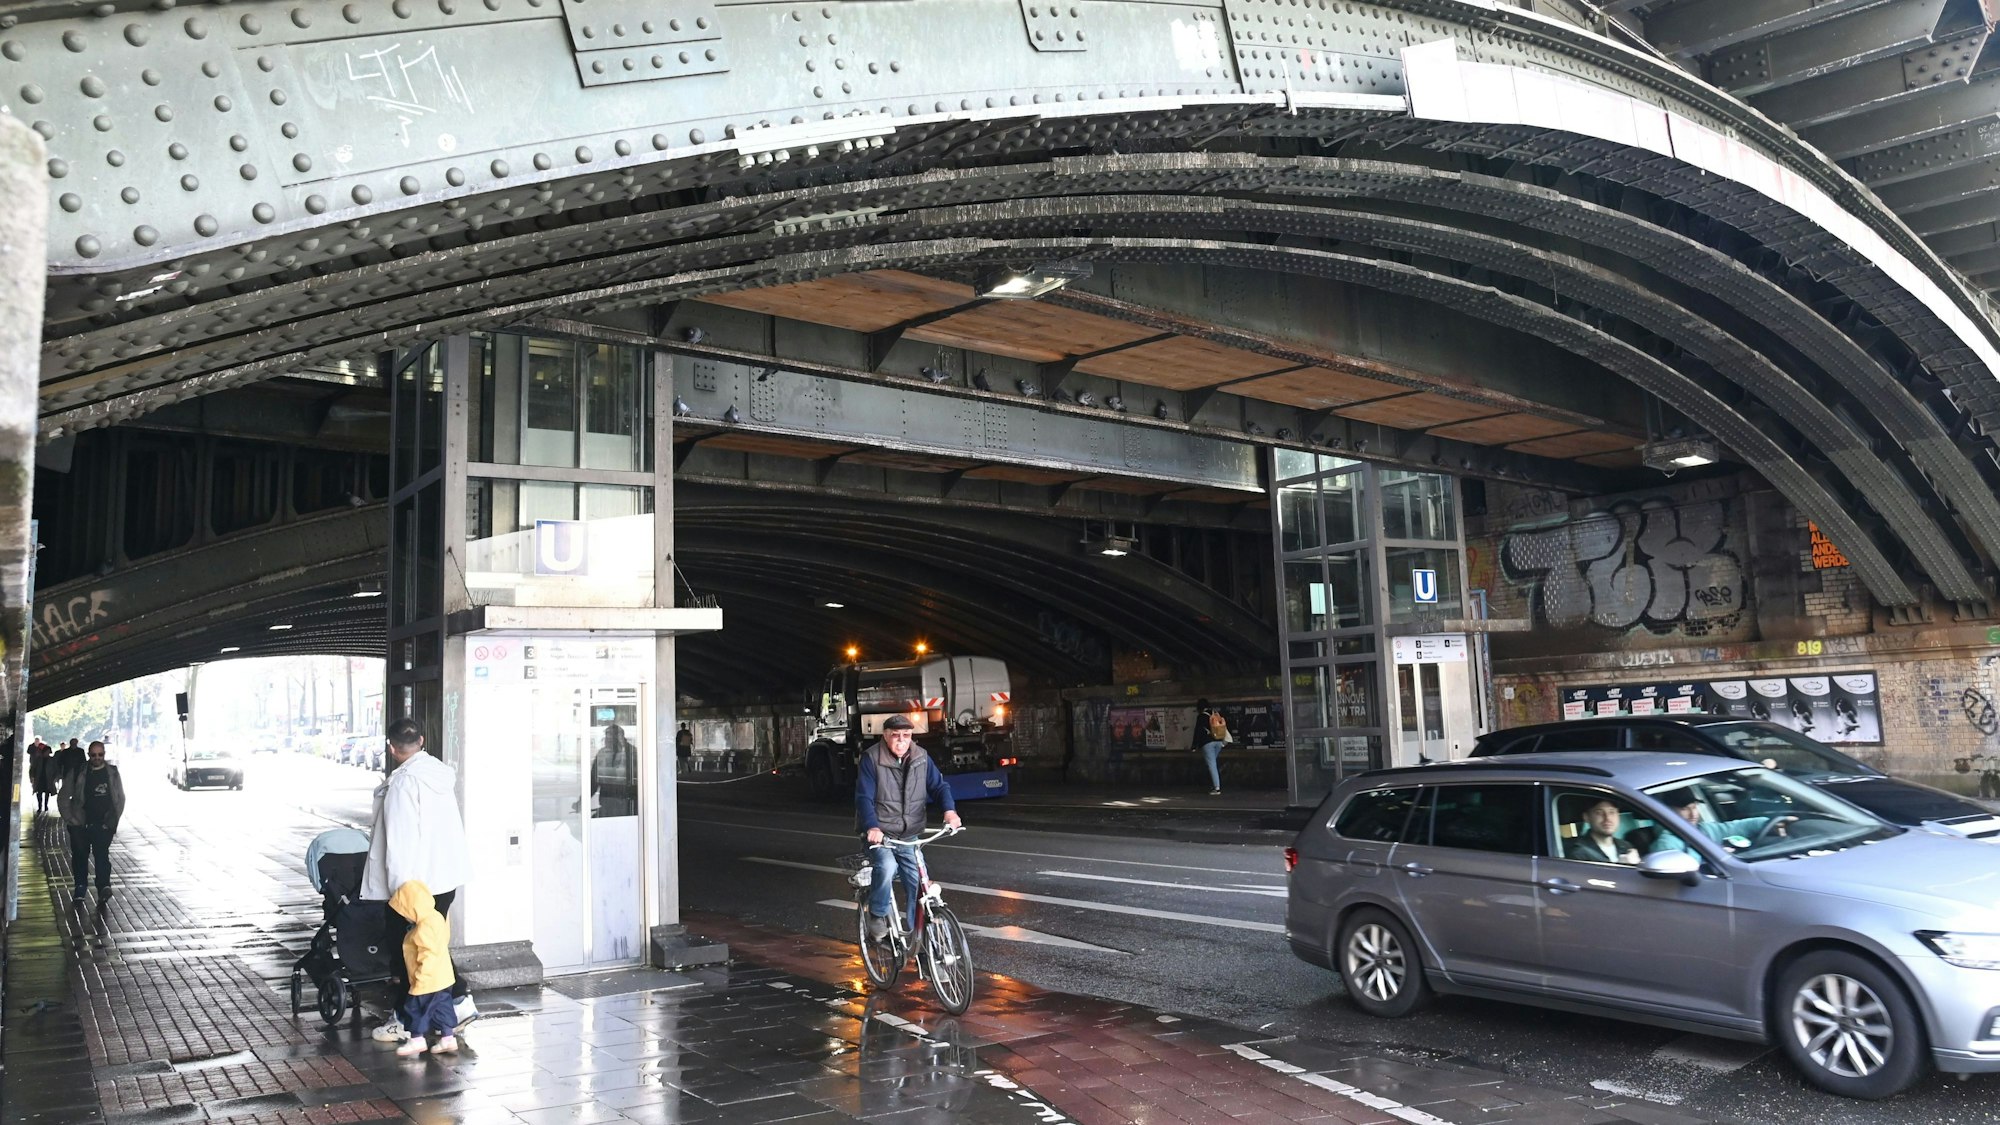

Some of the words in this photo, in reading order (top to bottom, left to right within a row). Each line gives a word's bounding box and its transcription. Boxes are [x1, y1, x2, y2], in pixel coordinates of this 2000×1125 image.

[541, 523, 583, 571] U
[1813, 555, 1850, 568] WERDE
[1415, 572, 1435, 600] U
[1349, 706, 1366, 716] TRA
